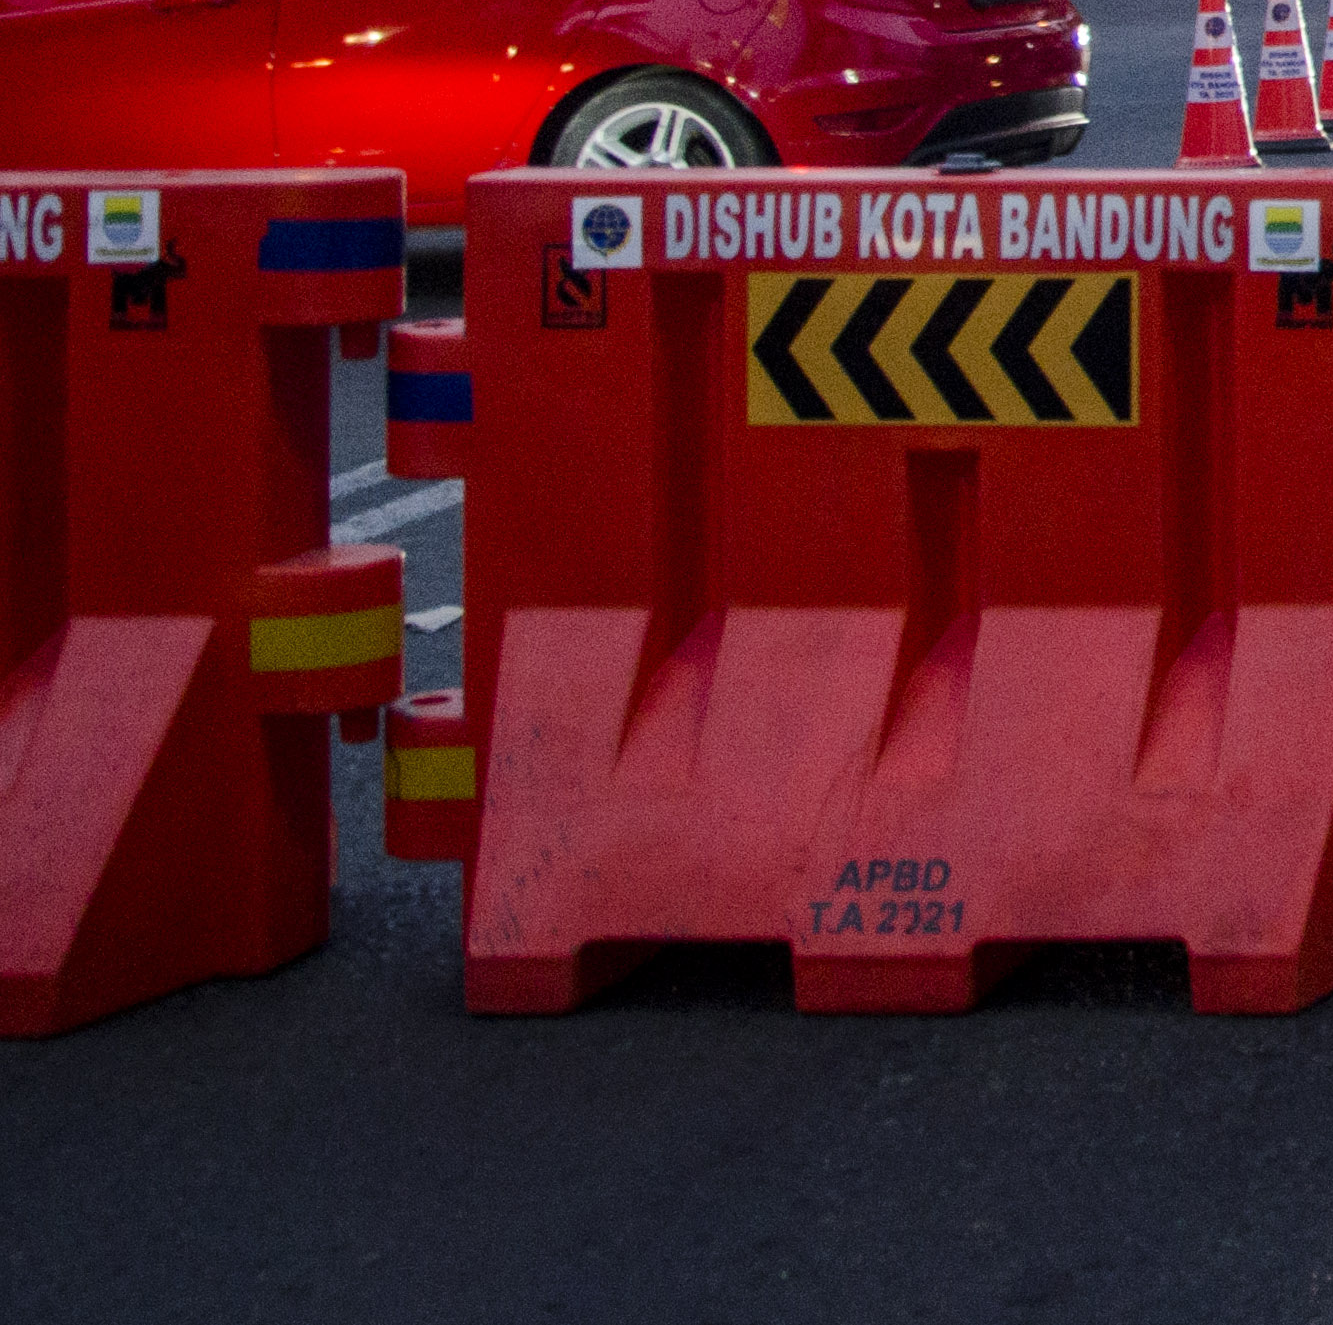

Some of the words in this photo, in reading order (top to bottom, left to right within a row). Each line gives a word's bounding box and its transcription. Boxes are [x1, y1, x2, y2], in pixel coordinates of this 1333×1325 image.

[664, 192, 843, 261] DISHUB
[858, 192, 985, 261] KOTA
[1000, 193, 1234, 264] BANDUNG
[835, 858, 952, 892] APBD
[876, 900, 966, 935] 2021
